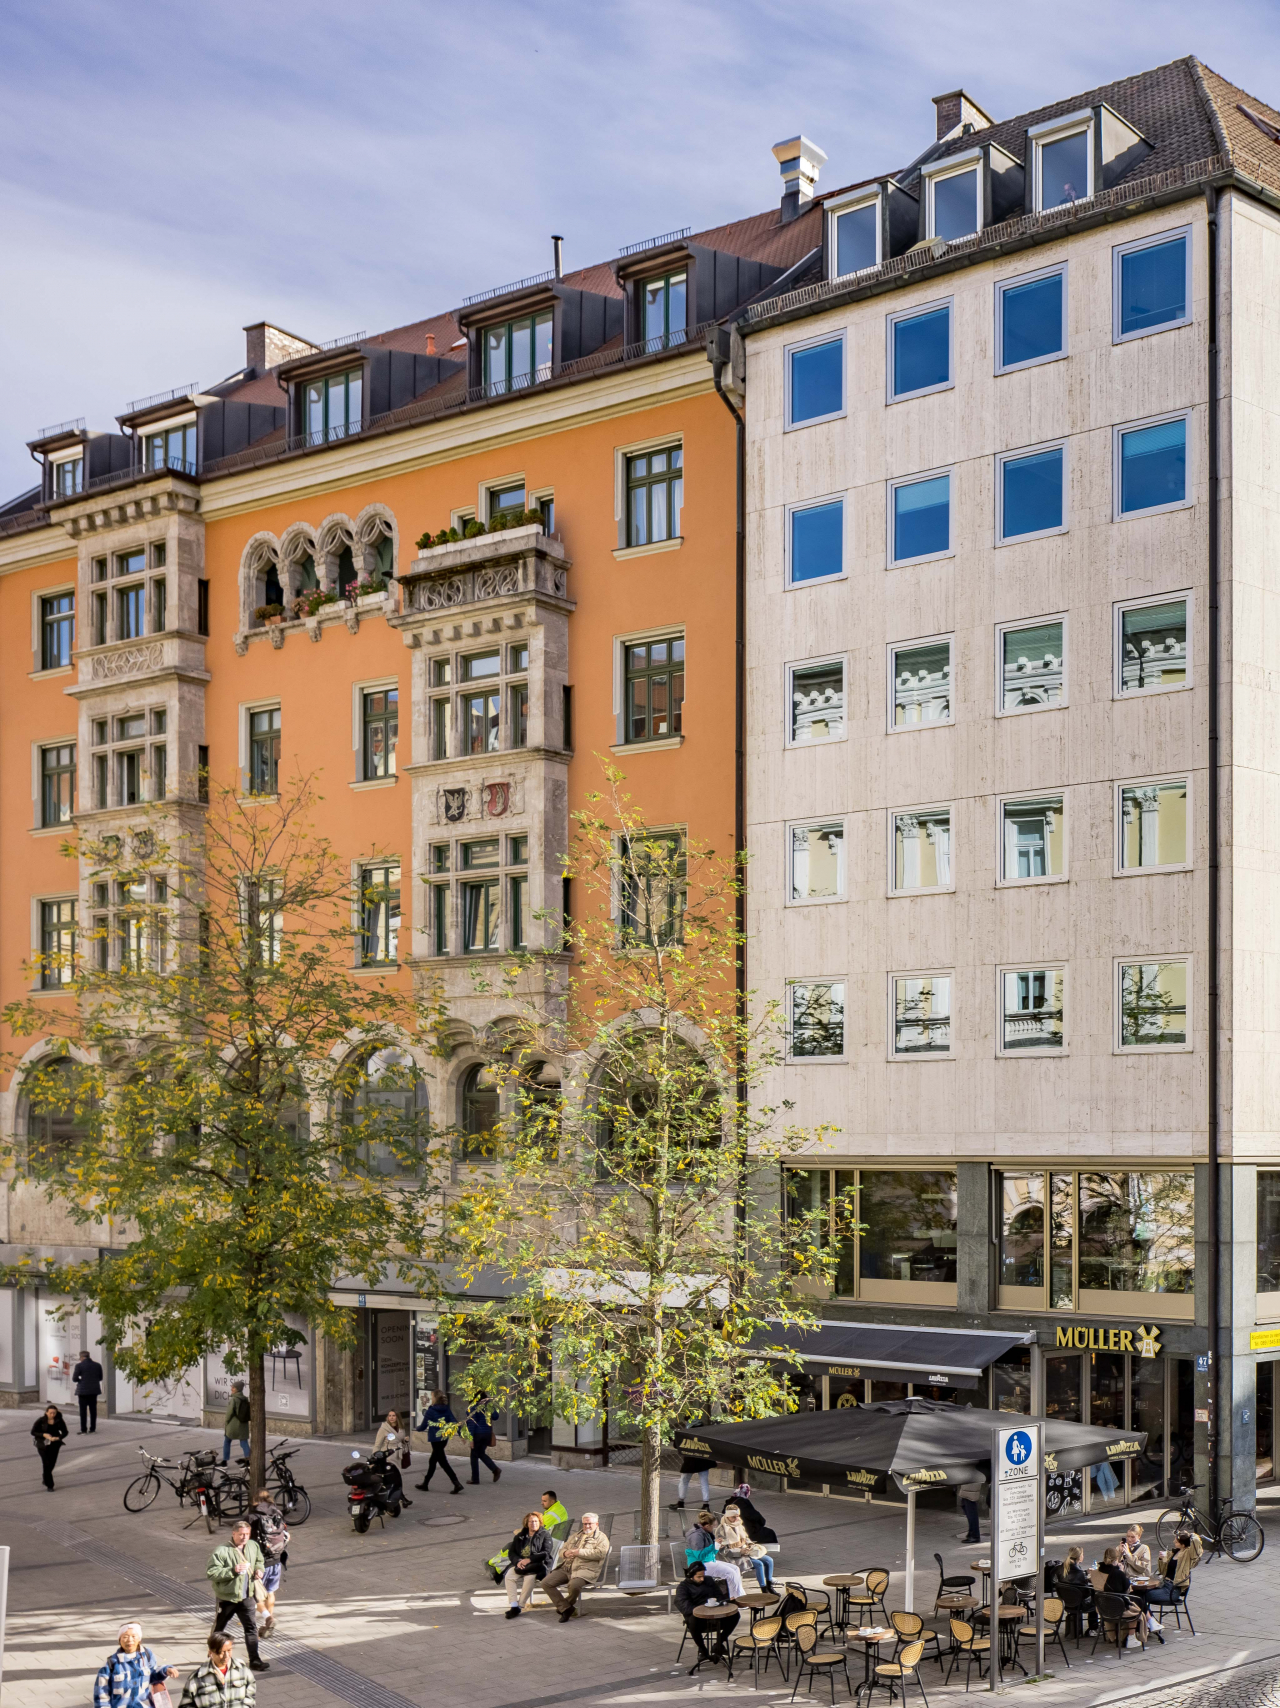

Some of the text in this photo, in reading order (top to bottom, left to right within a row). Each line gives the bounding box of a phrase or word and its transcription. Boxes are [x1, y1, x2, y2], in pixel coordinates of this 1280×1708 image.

[1056, 1326, 1134, 1351] MÜLLER
[1198, 1357, 1208, 1366] 47
[828, 1366, 853, 1376] MÜLLER
[214, 1377, 228, 1386] WIR
[1105, 1440, 1141, 1456] LAVAZZA
[747, 1454, 788, 1475] MÜLLER
[1009, 1466, 1029, 1476] ZONE
